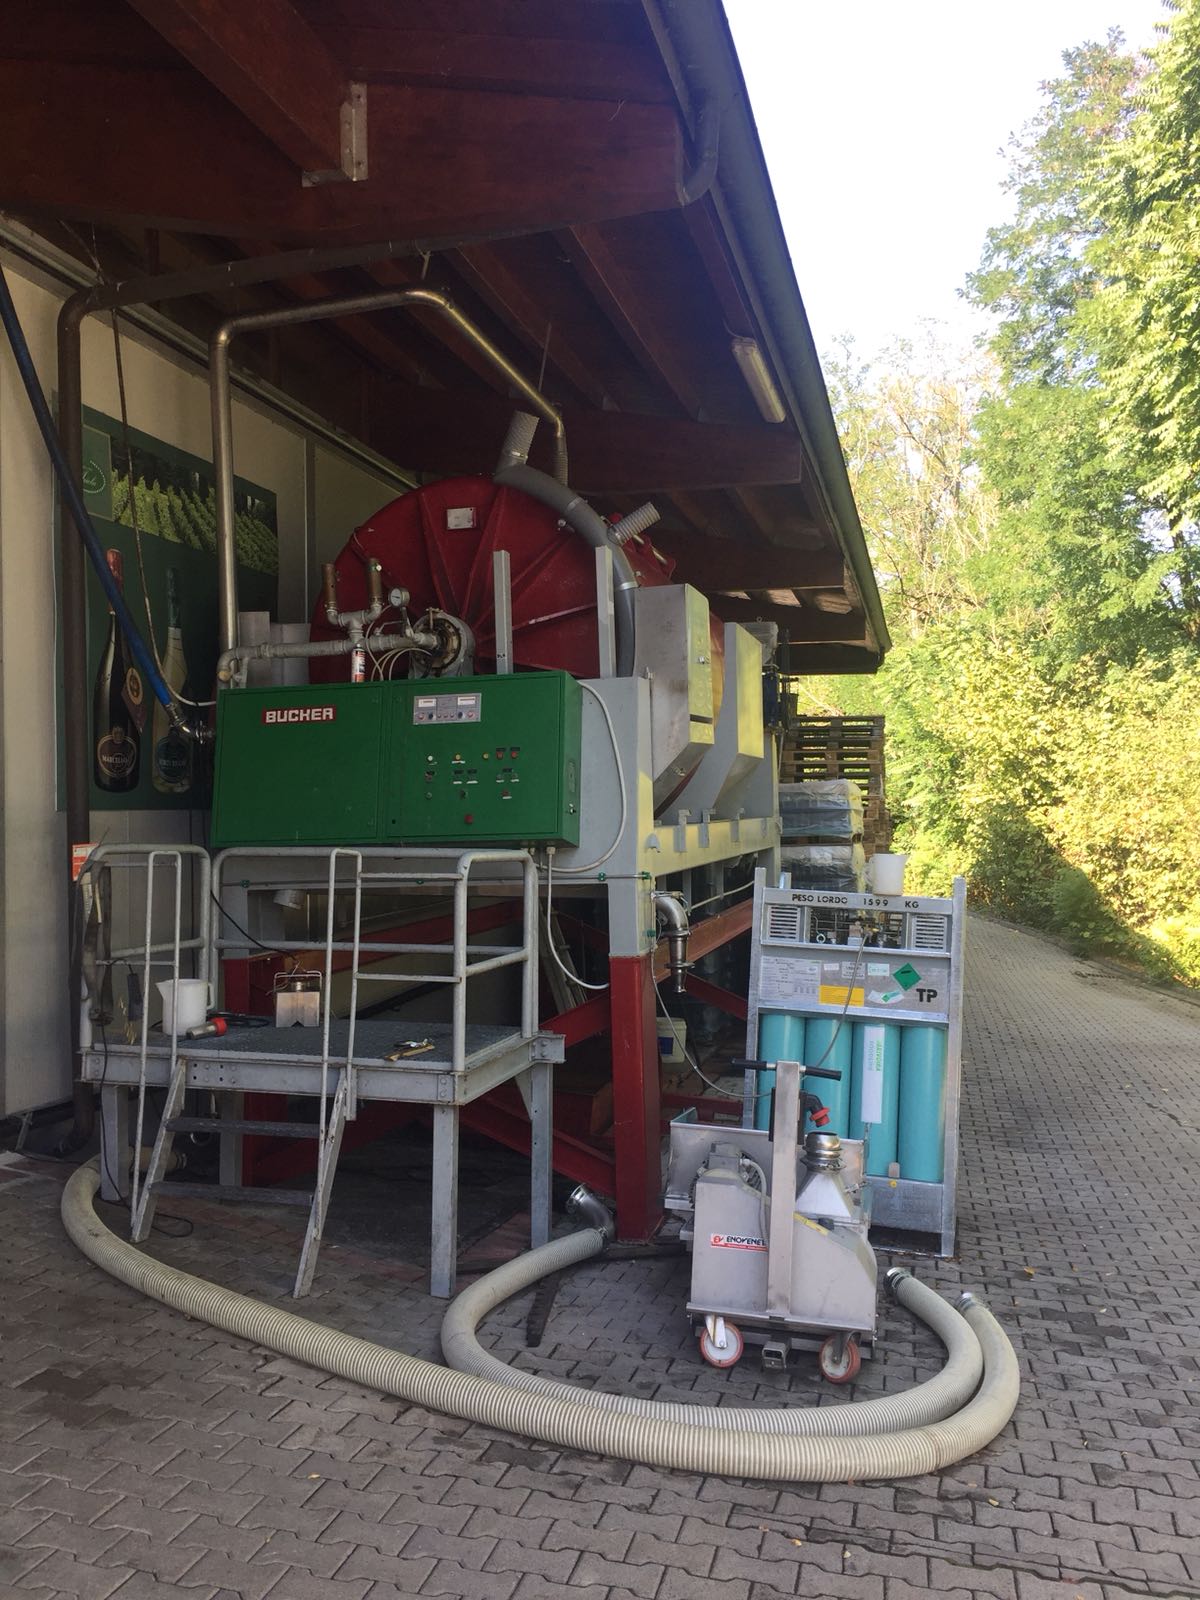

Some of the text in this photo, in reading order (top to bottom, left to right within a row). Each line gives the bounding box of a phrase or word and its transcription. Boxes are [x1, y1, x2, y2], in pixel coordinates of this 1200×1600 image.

[266, 708, 333, 723] BUCHER
[792, 894, 814, 902] PESO
[817, 896, 848, 904] LORDO
[863, 898, 888, 906] 1599
[916, 988, 938, 1002] TP
